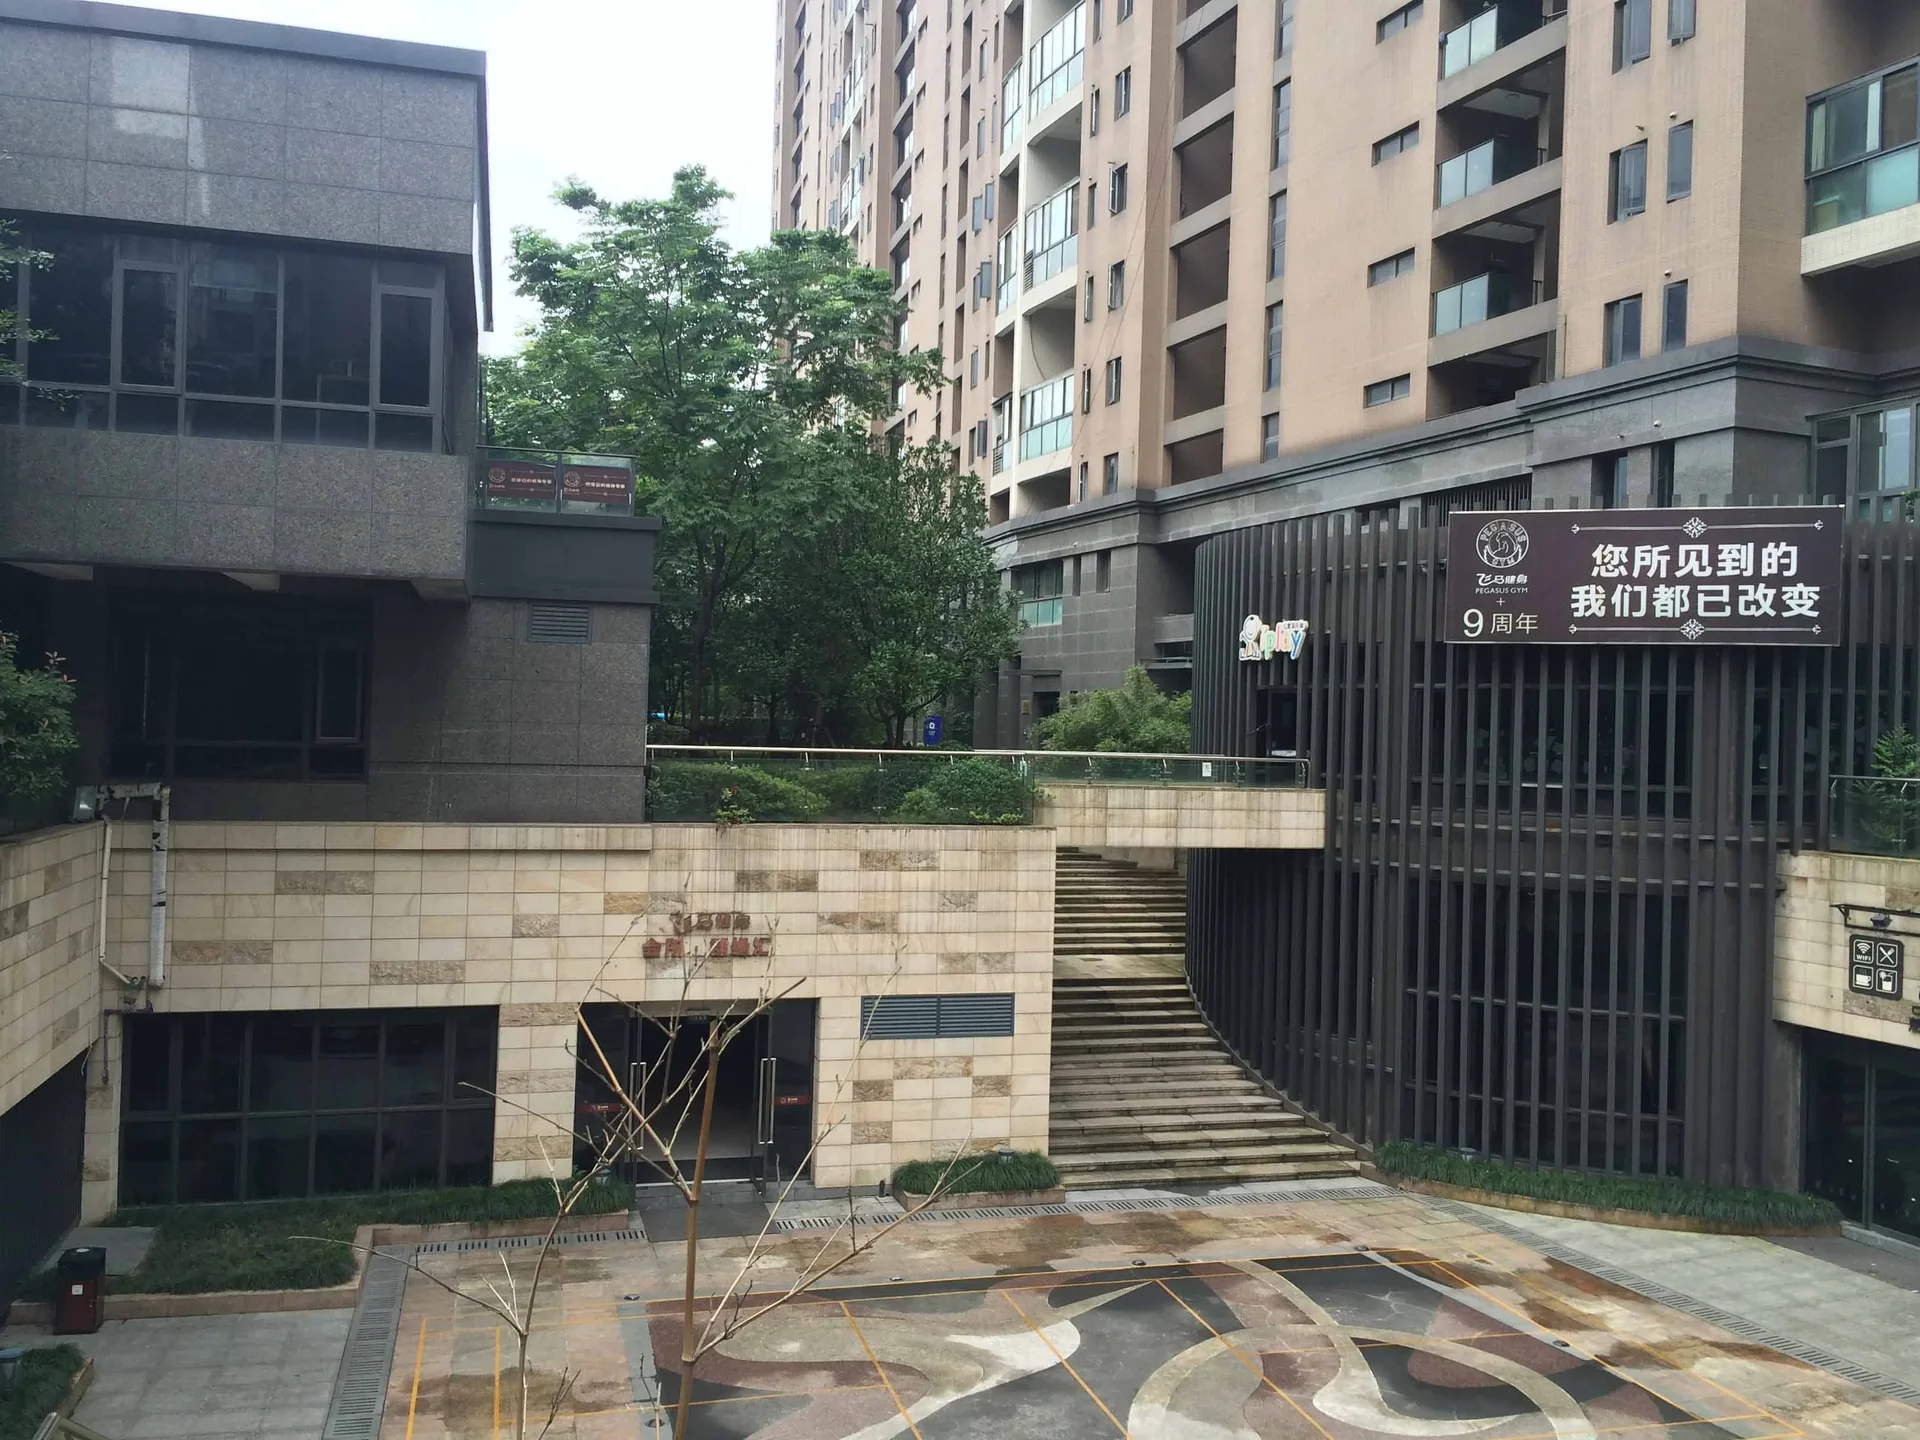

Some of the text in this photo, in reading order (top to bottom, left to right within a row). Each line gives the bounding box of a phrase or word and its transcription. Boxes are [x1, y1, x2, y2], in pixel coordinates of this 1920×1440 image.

[1480, 522, 1526, 542] PEGASUS
[1491, 558, 1516, 566] GYM
[1590, 541, 1798, 578] 您所见到的
[1476, 573, 1528, 586] 飞马健身
[1475, 587, 1509, 595] PEGASUS
[1570, 582, 1821, 618] 我们都已改变
